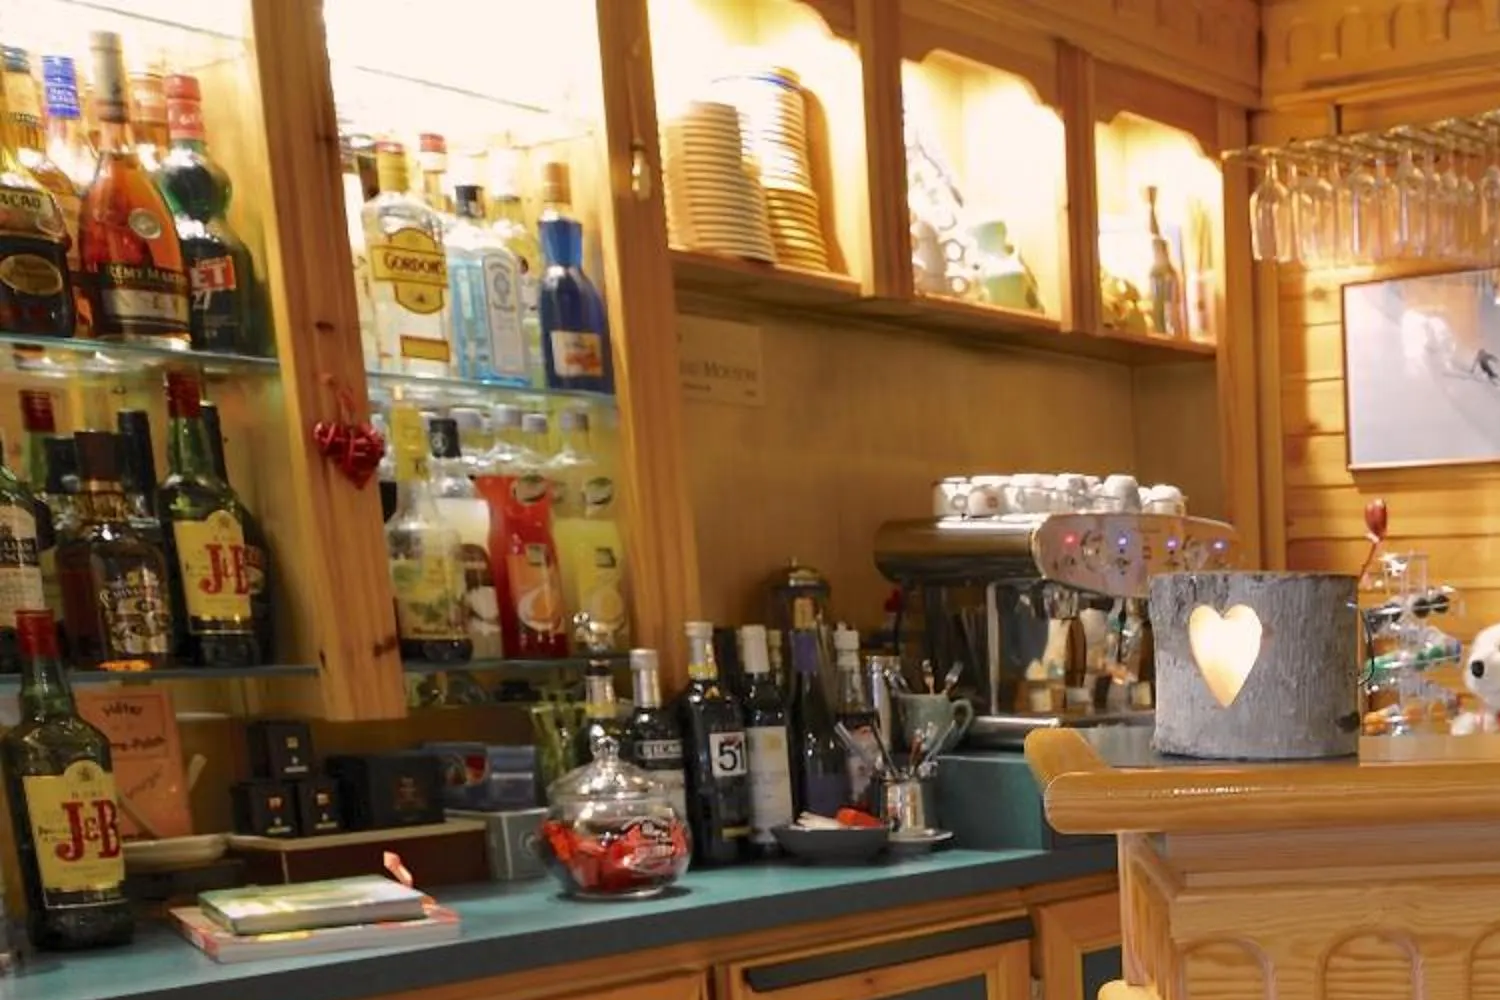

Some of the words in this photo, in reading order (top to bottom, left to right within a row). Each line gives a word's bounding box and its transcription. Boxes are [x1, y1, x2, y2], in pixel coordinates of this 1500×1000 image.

[383, 253, 446, 279] GORDON
[719, 740, 745, 771] 51
[55, 798, 120, 861] J&B
